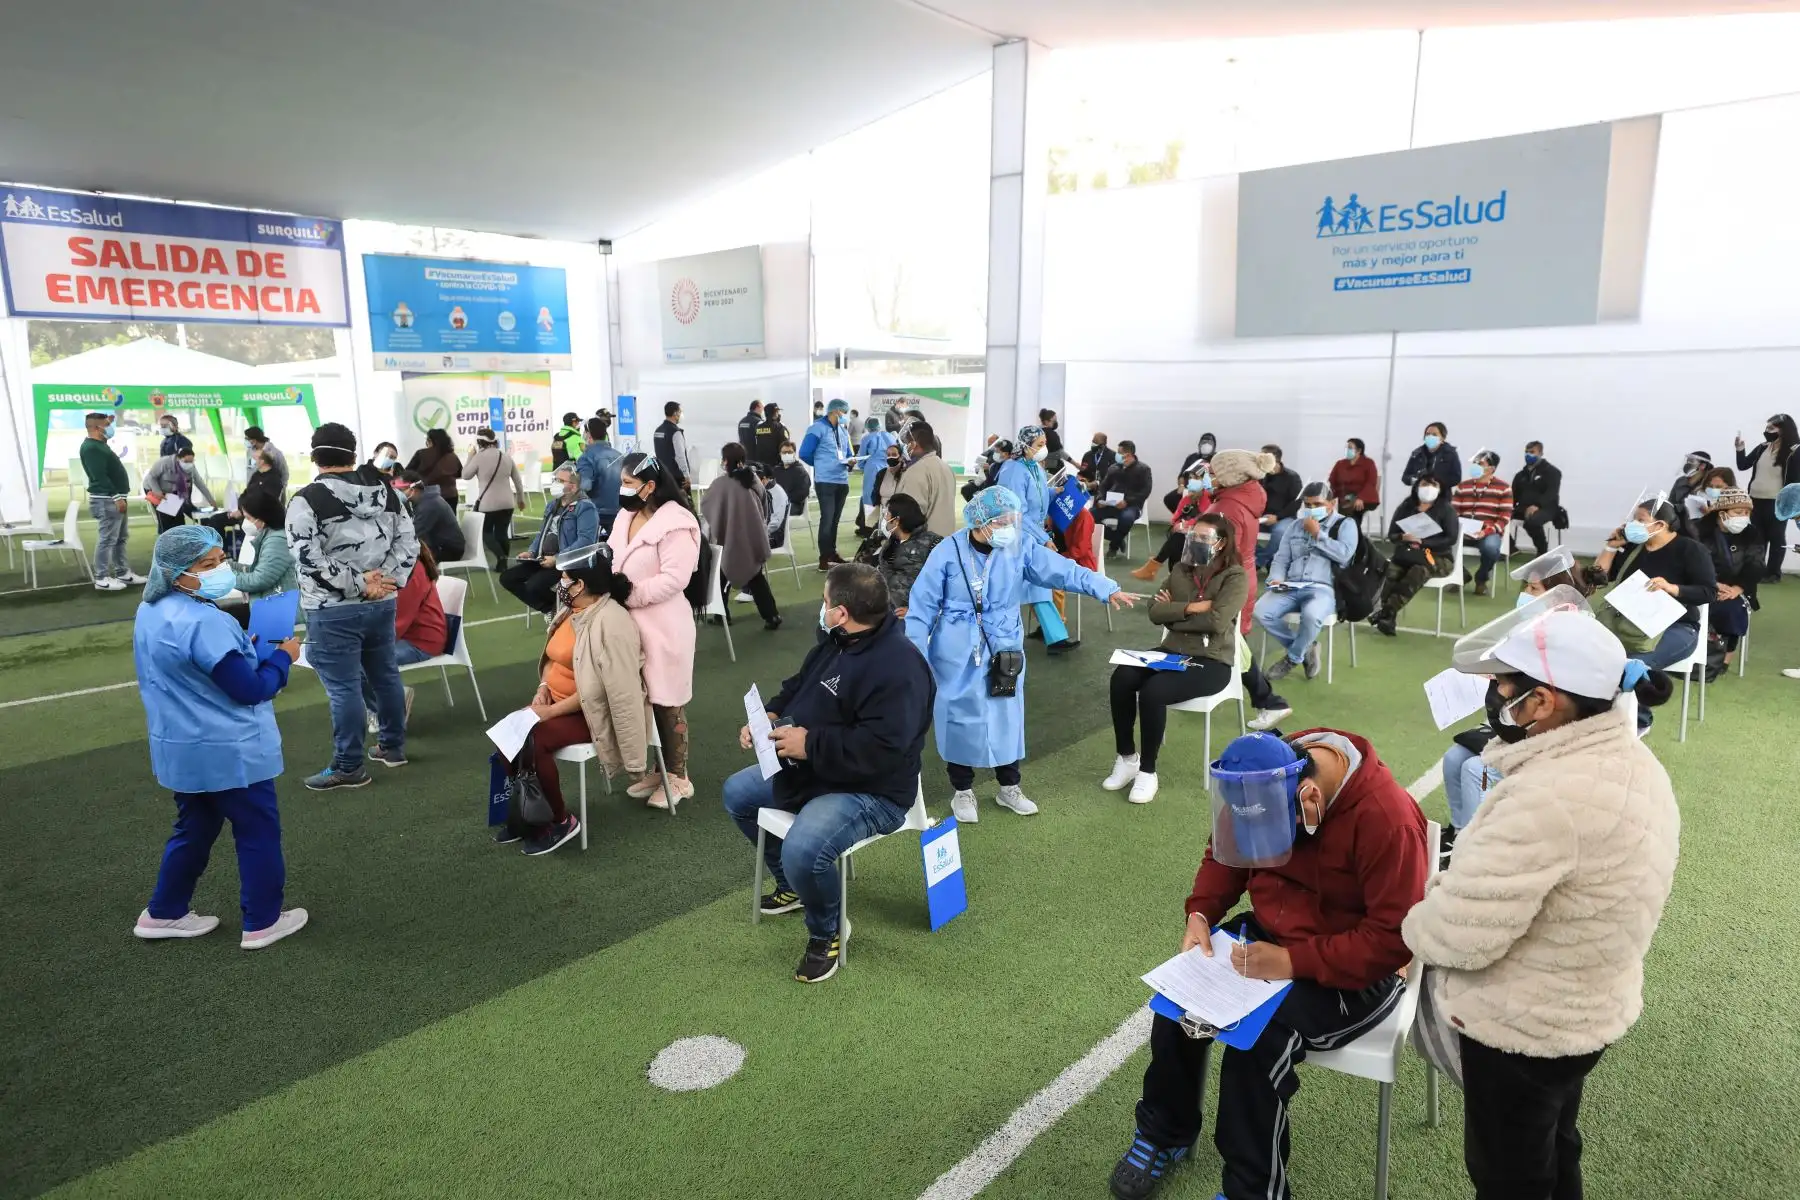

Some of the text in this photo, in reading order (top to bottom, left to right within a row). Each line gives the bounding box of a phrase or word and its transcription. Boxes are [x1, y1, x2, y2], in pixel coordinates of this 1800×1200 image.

[48, 207, 123, 228] EsSalud
[1379, 190, 1506, 232] EsSalud
[1332, 235, 1478, 256] Por un servicio oportuno
[67, 236, 286, 279] SALIDA DE
[1371, 258, 1378, 269] y
[1382, 254, 1417, 267] mejor
[1421, 252, 1450, 265] para
[1336, 269, 1468, 289] #VacunarseEsSalud
[45, 273, 321, 314] EMERGENCIA
[703, 287, 748, 298] BICENTENARIO
[721, 298, 734, 306] 2021
[167, 398, 223, 407] SURQUILLO
[455, 394, 532, 411] ¡Surillo
[456, 407, 534, 424] empó la
[1055, 497, 1074, 520] EsSalud
[932, 854, 954, 874] EsSalud
